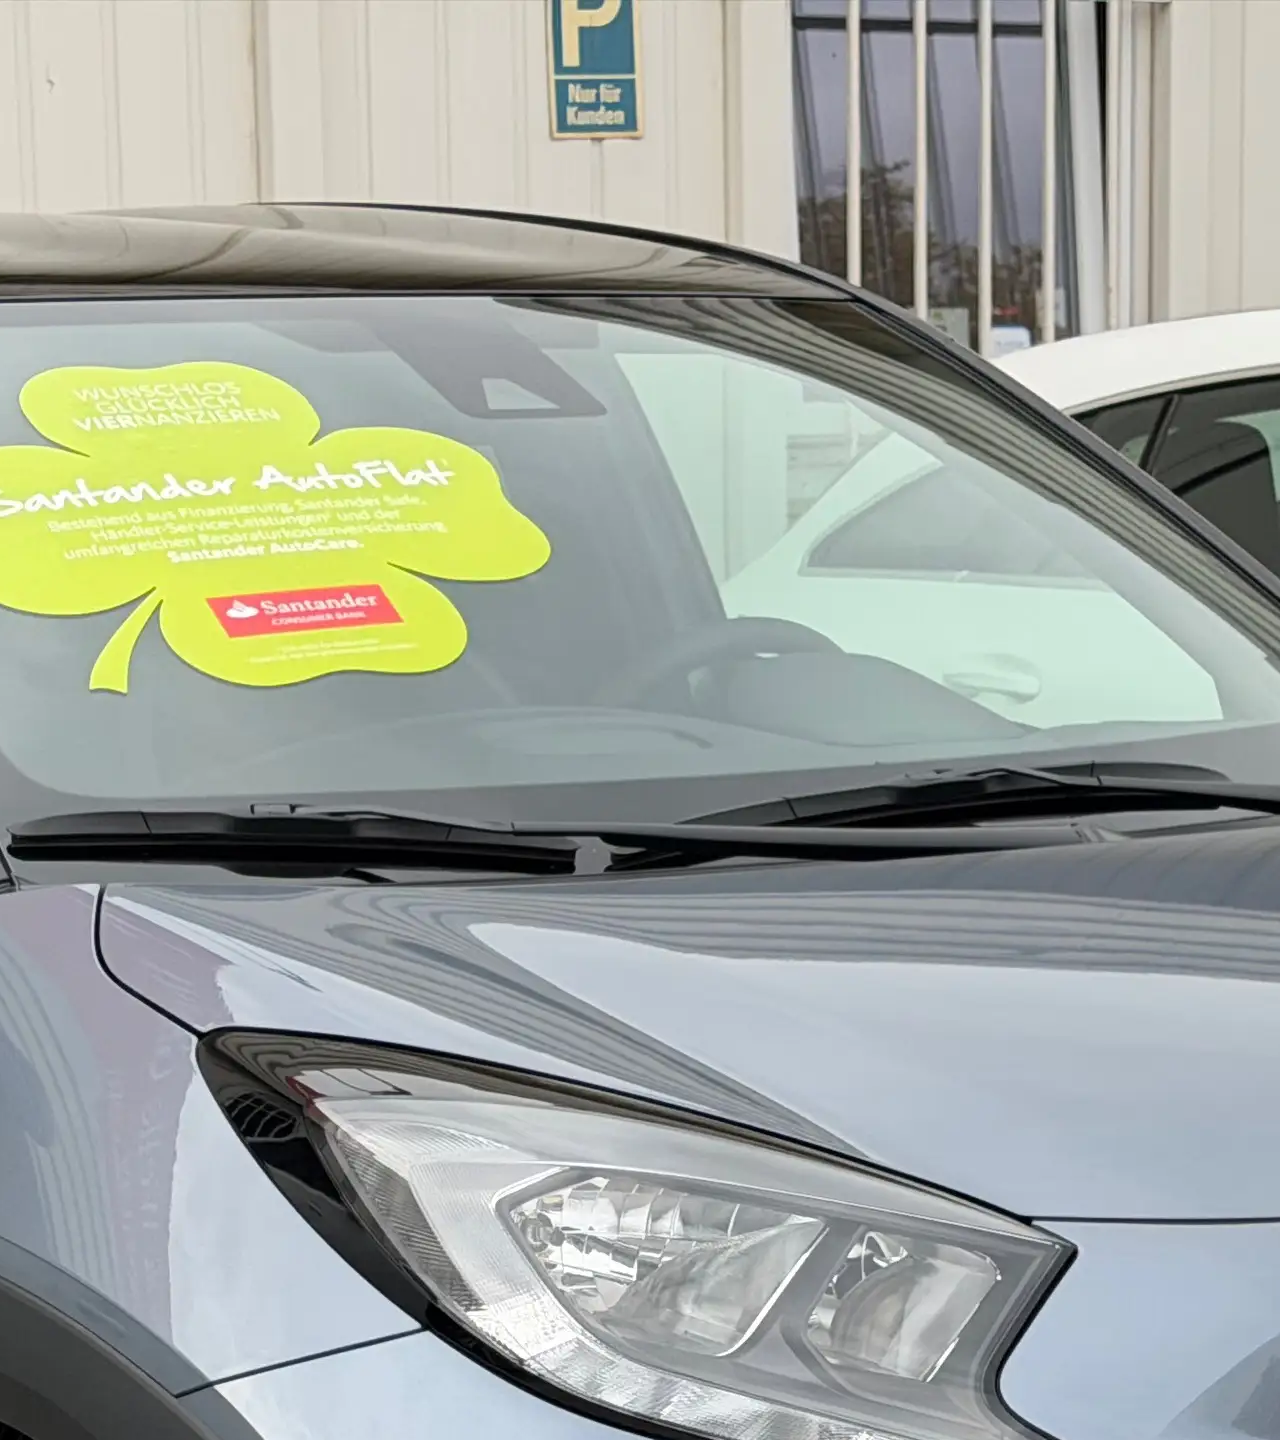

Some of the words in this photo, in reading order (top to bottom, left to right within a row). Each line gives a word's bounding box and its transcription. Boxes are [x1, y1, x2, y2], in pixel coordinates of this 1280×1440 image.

[567, 83, 597, 103] Nur
[599, 83, 622, 103] für
[566, 105, 625, 125] Kunden
[73, 381, 242, 402] WUNSCHLOS
[72, 407, 281, 432] VIERNANZIEREN
[47, 510, 143, 532] Bestehend
[146, 510, 176, 522] aus
[294, 495, 381, 512] Santander
[336, 510, 371, 522] und
[373, 508, 400, 520] der
[64, 537, 196, 561] umfangreichen
[167, 544, 265, 564] Santander
[270, 538, 364, 556] AutoCare.
[260, 592, 379, 615] Santander
